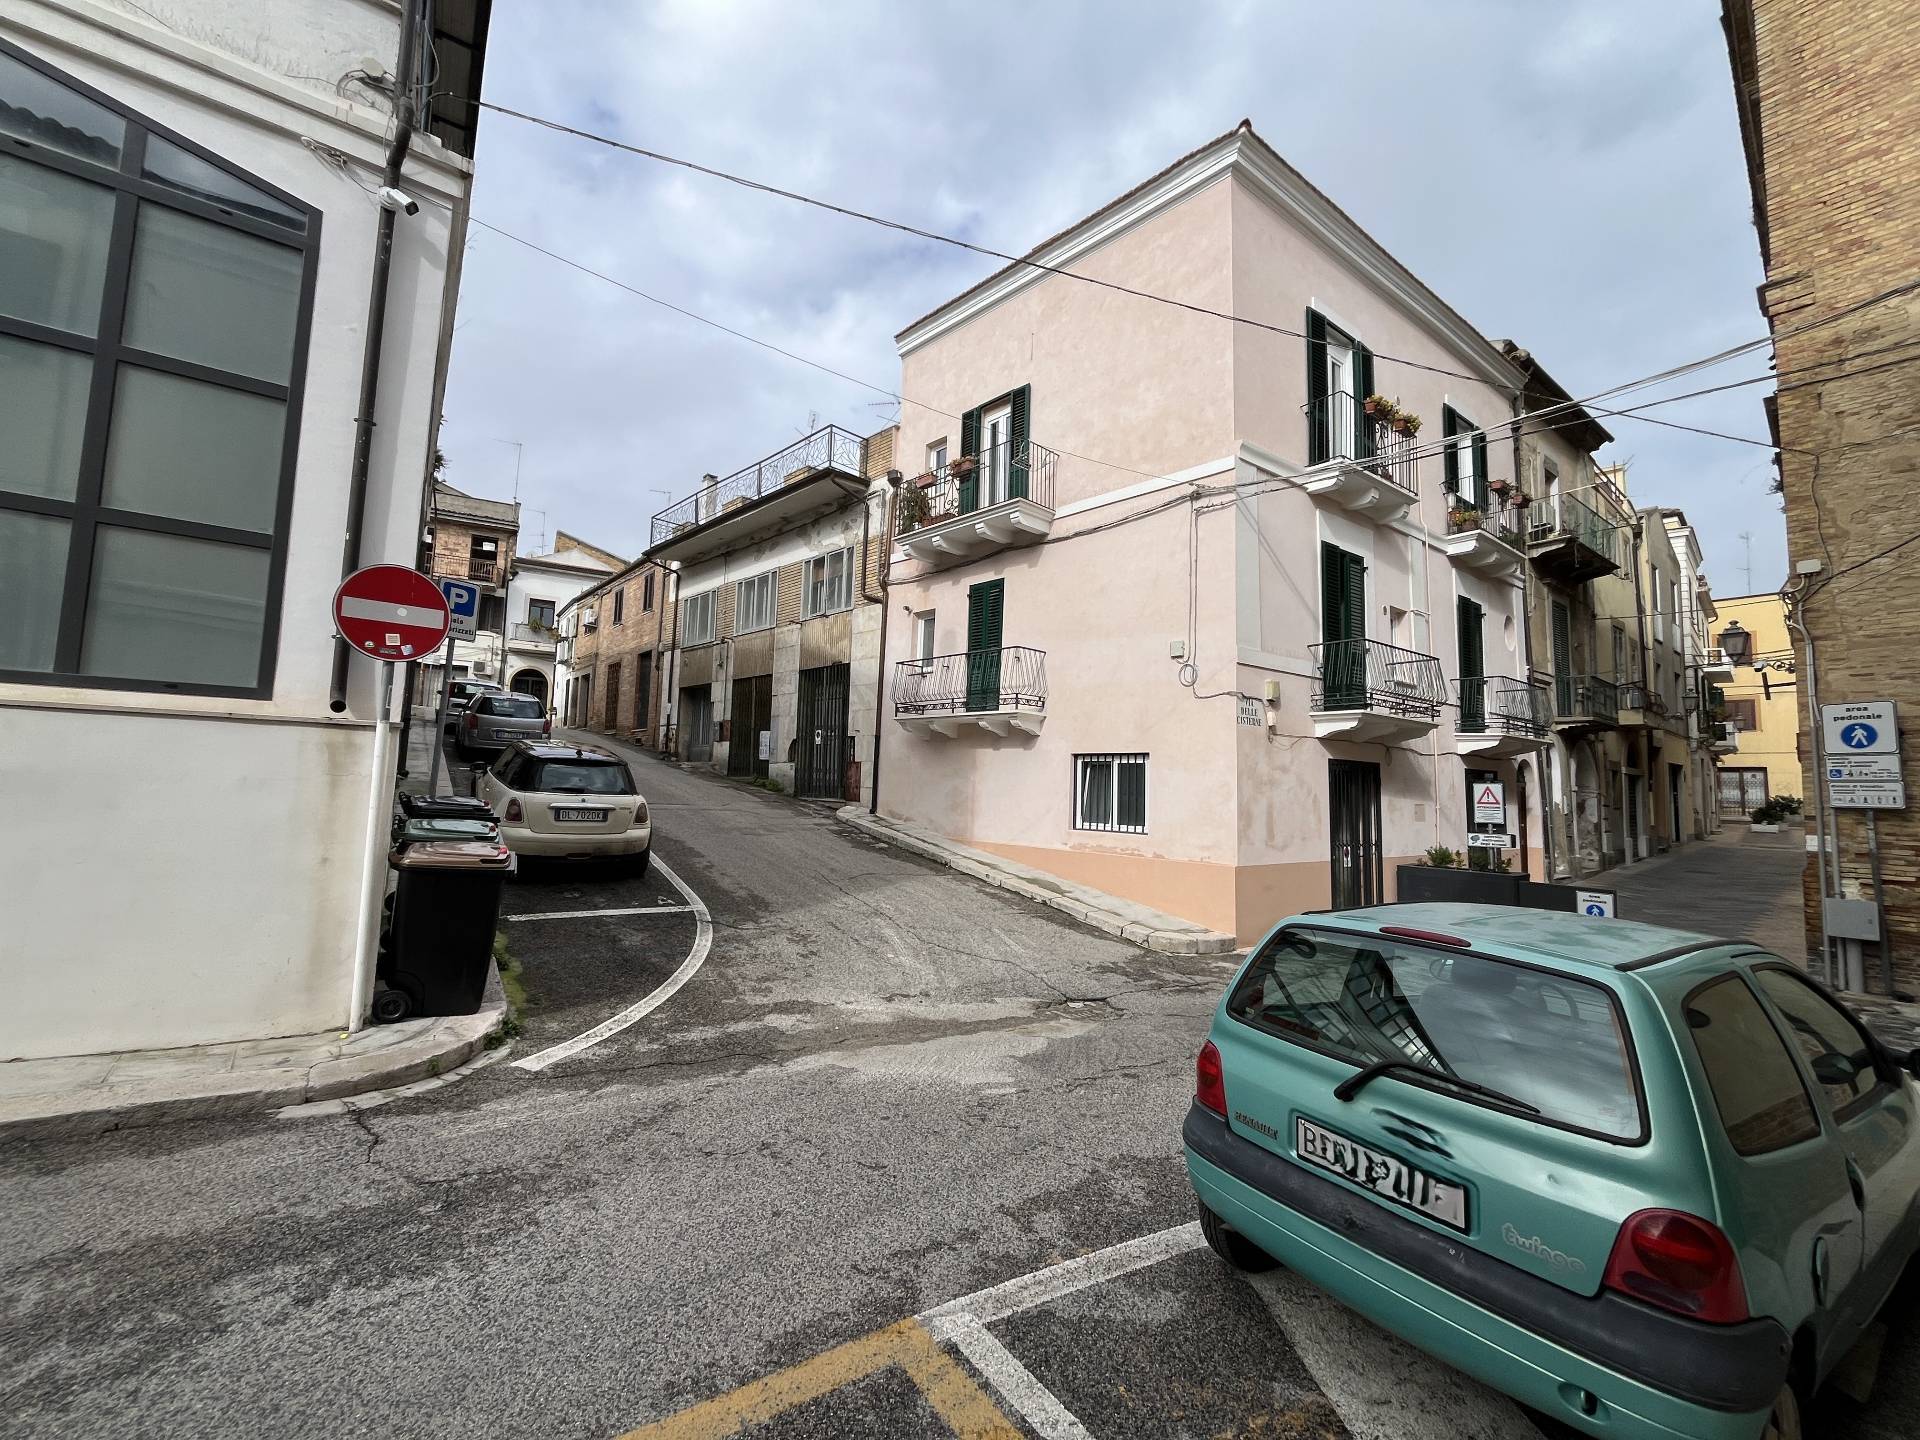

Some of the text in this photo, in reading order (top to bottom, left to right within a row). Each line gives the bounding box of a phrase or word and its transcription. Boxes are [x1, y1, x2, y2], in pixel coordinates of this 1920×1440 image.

[450, 586, 469, 609] P
[1240, 707, 1258, 717] DELLE
[1236, 716, 1262, 727] CISTERNE
[1833, 713, 1883, 722] pedonale
